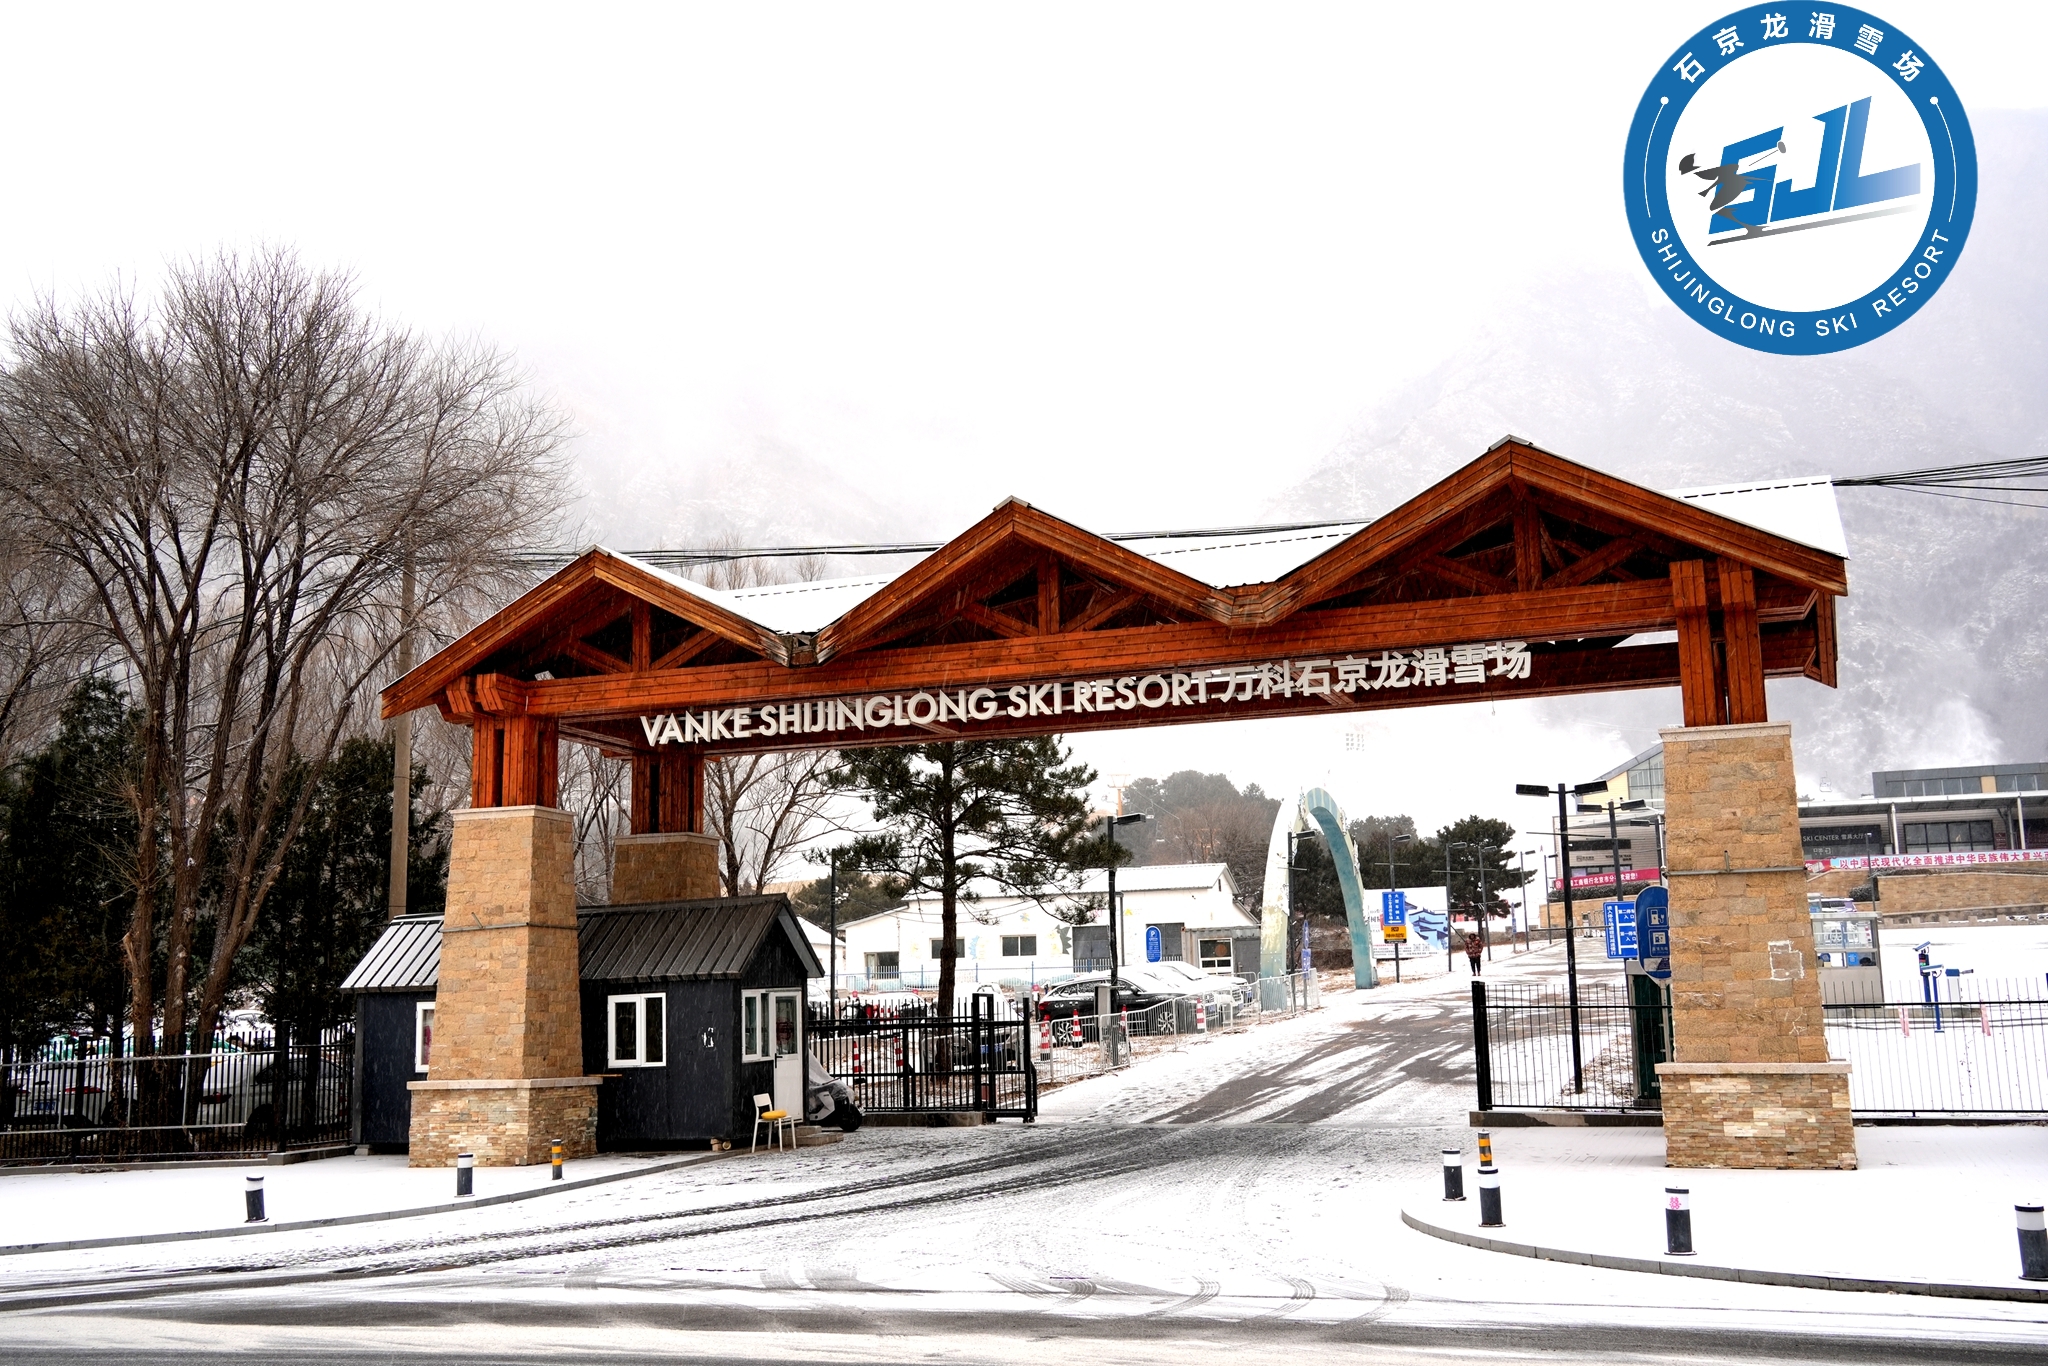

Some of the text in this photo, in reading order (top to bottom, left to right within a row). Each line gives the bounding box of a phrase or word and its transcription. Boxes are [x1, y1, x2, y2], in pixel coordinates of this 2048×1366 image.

[1221, 641, 1532, 703] 万科石京龙滑雪场
[639, 671, 1212, 747] VANKE SHIJINGLONG SKI RESORT
